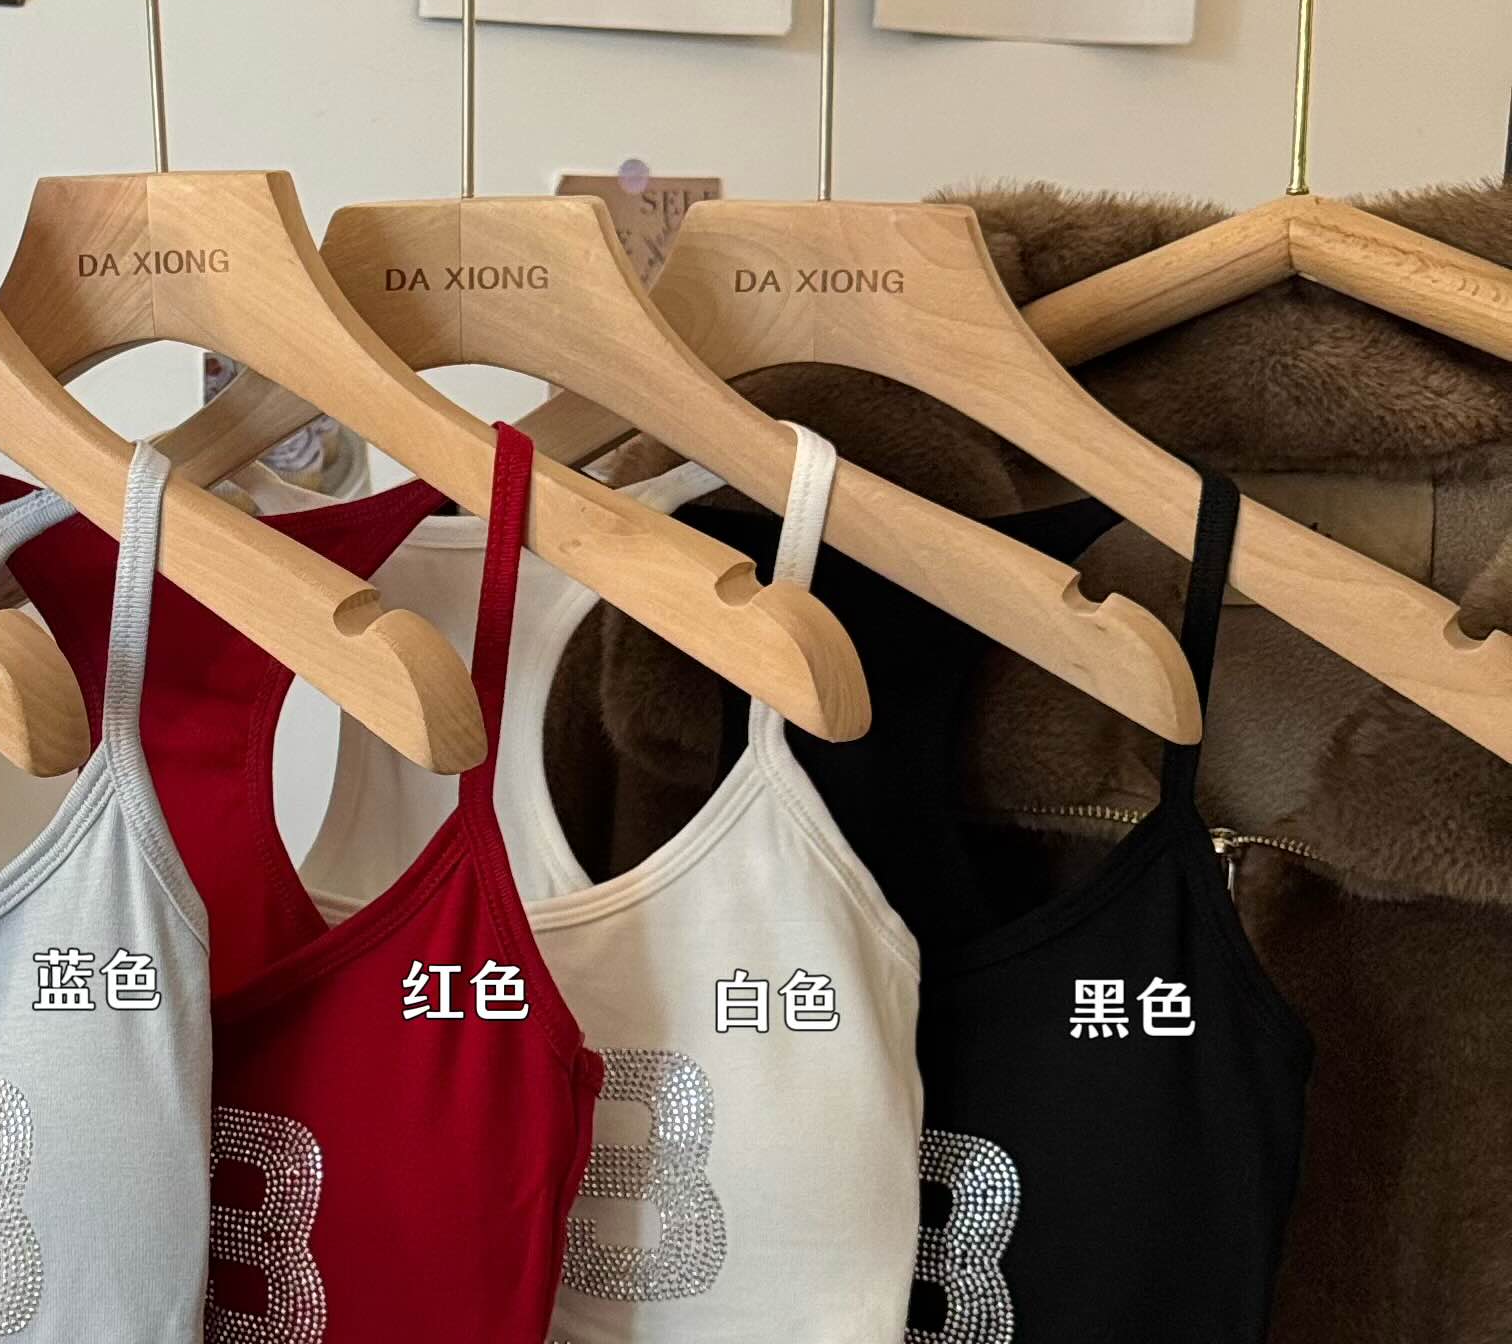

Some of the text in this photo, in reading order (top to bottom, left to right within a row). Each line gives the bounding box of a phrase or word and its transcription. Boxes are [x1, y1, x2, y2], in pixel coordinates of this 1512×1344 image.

[78, 249, 231, 277] DA XIONG
[385, 265, 550, 292] DA XIONG
[734, 268, 906, 294] DA XIONG
